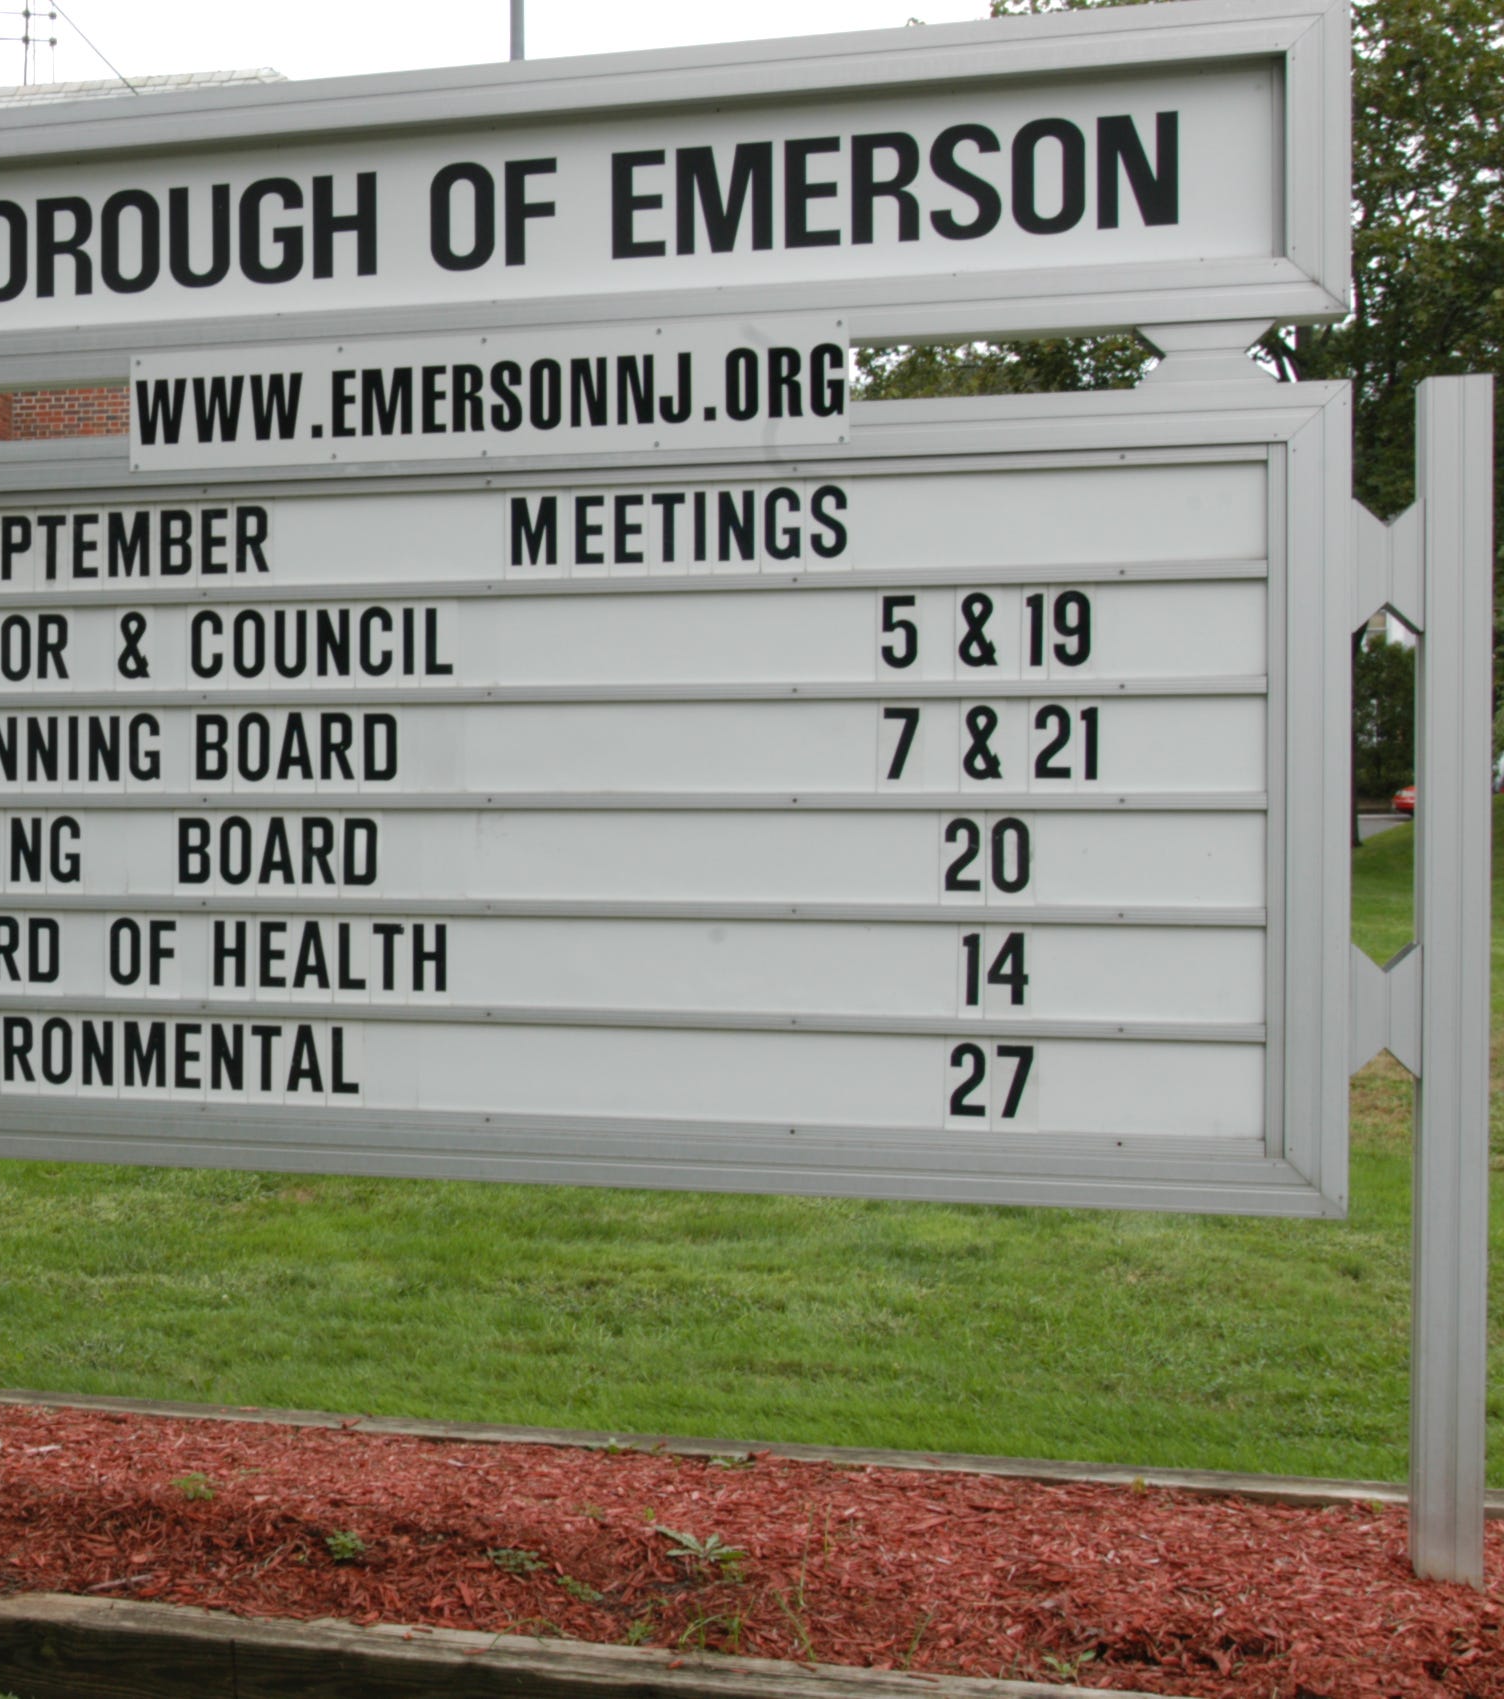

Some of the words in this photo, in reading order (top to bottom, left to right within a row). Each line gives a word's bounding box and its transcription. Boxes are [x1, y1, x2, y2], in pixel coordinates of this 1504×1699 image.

[429, 157, 557, 272] OF
[611, 110, 1179, 260] EMERSON
[135, 342, 845, 446] WWW.EMERSONNJ.ORG
[510, 484, 847, 566] MEETINGS
[117, 610, 150, 680] &
[191, 605, 453, 679] COUNCIL
[881, 594, 918, 669] 5
[958, 591, 998, 668] &
[1026, 589, 1091, 667] 19
[195, 711, 398, 782] BOARD
[883, 707, 920, 780] 7
[963, 704, 1002, 781] &
[1034, 703, 1099, 781] 21
[178, 815, 378, 886] BOARD
[945, 816, 1030, 894] 20
[109, 916, 177, 986] OF
[213, 920, 447, 992] HEALTH
[962, 932, 1029, 1006] 14
[950, 1042, 1034, 1119] 27
